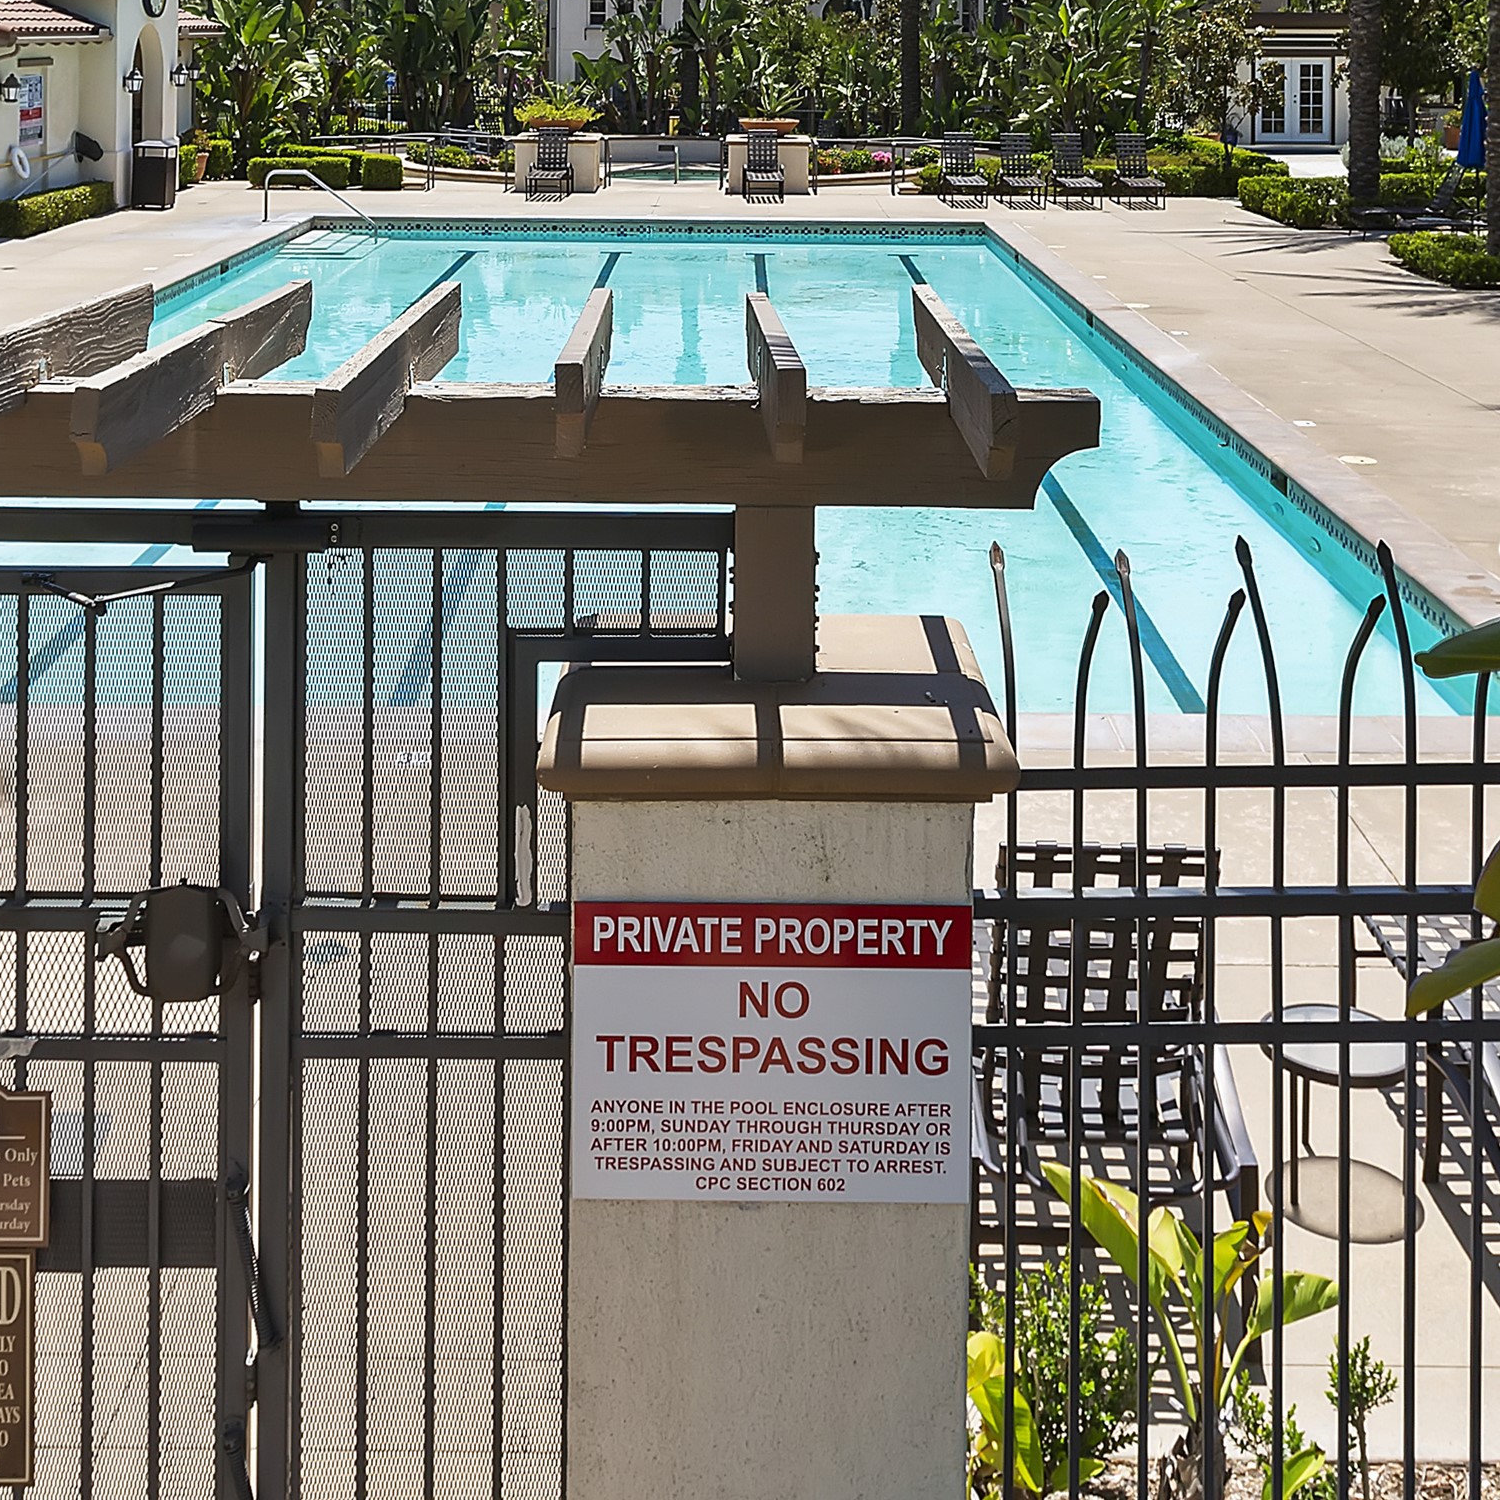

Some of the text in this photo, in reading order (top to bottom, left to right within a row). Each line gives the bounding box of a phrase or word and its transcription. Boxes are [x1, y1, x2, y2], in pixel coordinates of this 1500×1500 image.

[593, 917, 953, 955] PRIVATE PROPERTY
[738, 981, 809, 1018] NO
[596, 1035, 950, 1076] TRESPASSING
[591, 1100, 951, 1117] ANYONE IN THE POOL ENCLOSURE AFTER
[591, 1120, 951, 1136] 9:00PM, SUNDAY THROUGH THURSDAY OR
[591, 1138, 950, 1155] AFTER 10:00PM, FRIDAY AND SATURDAY IS
[5, 1149, 37, 1165] Only
[595, 1157, 946, 1173] TRESPASSING AND SUBJECT TO ARREST.
[3, 1175, 30, 1187] Pets
[696, 1177, 845, 1191] CPC SECTION 602
